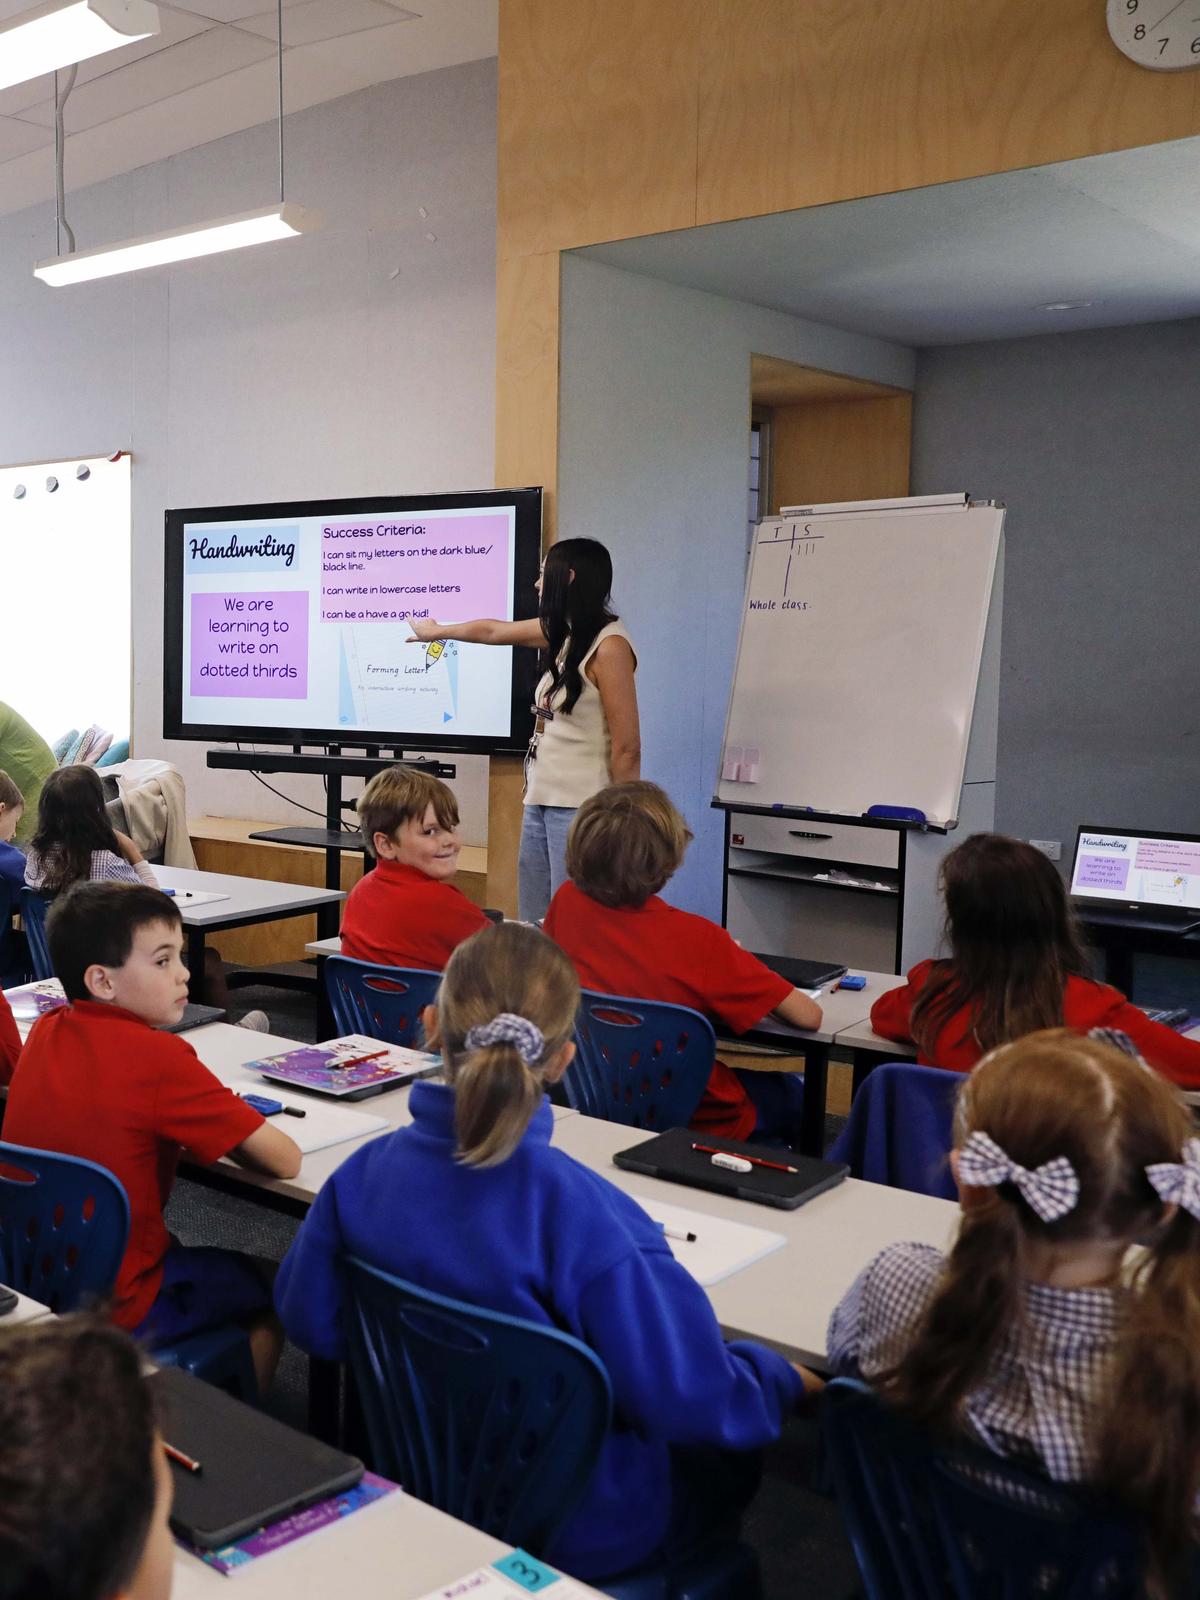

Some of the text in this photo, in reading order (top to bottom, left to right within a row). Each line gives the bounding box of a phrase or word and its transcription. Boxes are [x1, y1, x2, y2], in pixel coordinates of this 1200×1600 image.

[1126, 0, 1138, 15] 9
[1134, 24, 1145, 40] 8
[1157, 37, 1169, 55] 7
[1191, 37, 1200, 53] 6
[323, 524, 426, 539] Success Criteria:
[189, 534, 295, 567] Handwriting
[323, 544, 493, 560] I can sit my letters on the dark blue/
[323, 562, 365, 571] black line.
[345, 586, 368, 594] write
[369, 586, 378, 594] in
[380, 585, 427, 594] lowercase
[428, 584, 461, 593] letters
[224, 598, 274, 612] We are
[749, 600, 776, 609] Whole
[326, 611, 343, 619] can
[345, 609, 356, 619] be
[365, 609, 388, 618] have
[398, 611, 411, 621] go
[412, 609, 429, 618] kid!
[209, 618, 289, 637] learning to
[218, 640, 279, 654] write on
[200, 662, 297, 678] dotted thirds
[367, 664, 399, 677] Forming
[1083, 838, 1127, 850] Handwriting
[510, 1560, 540, 1585] 3
